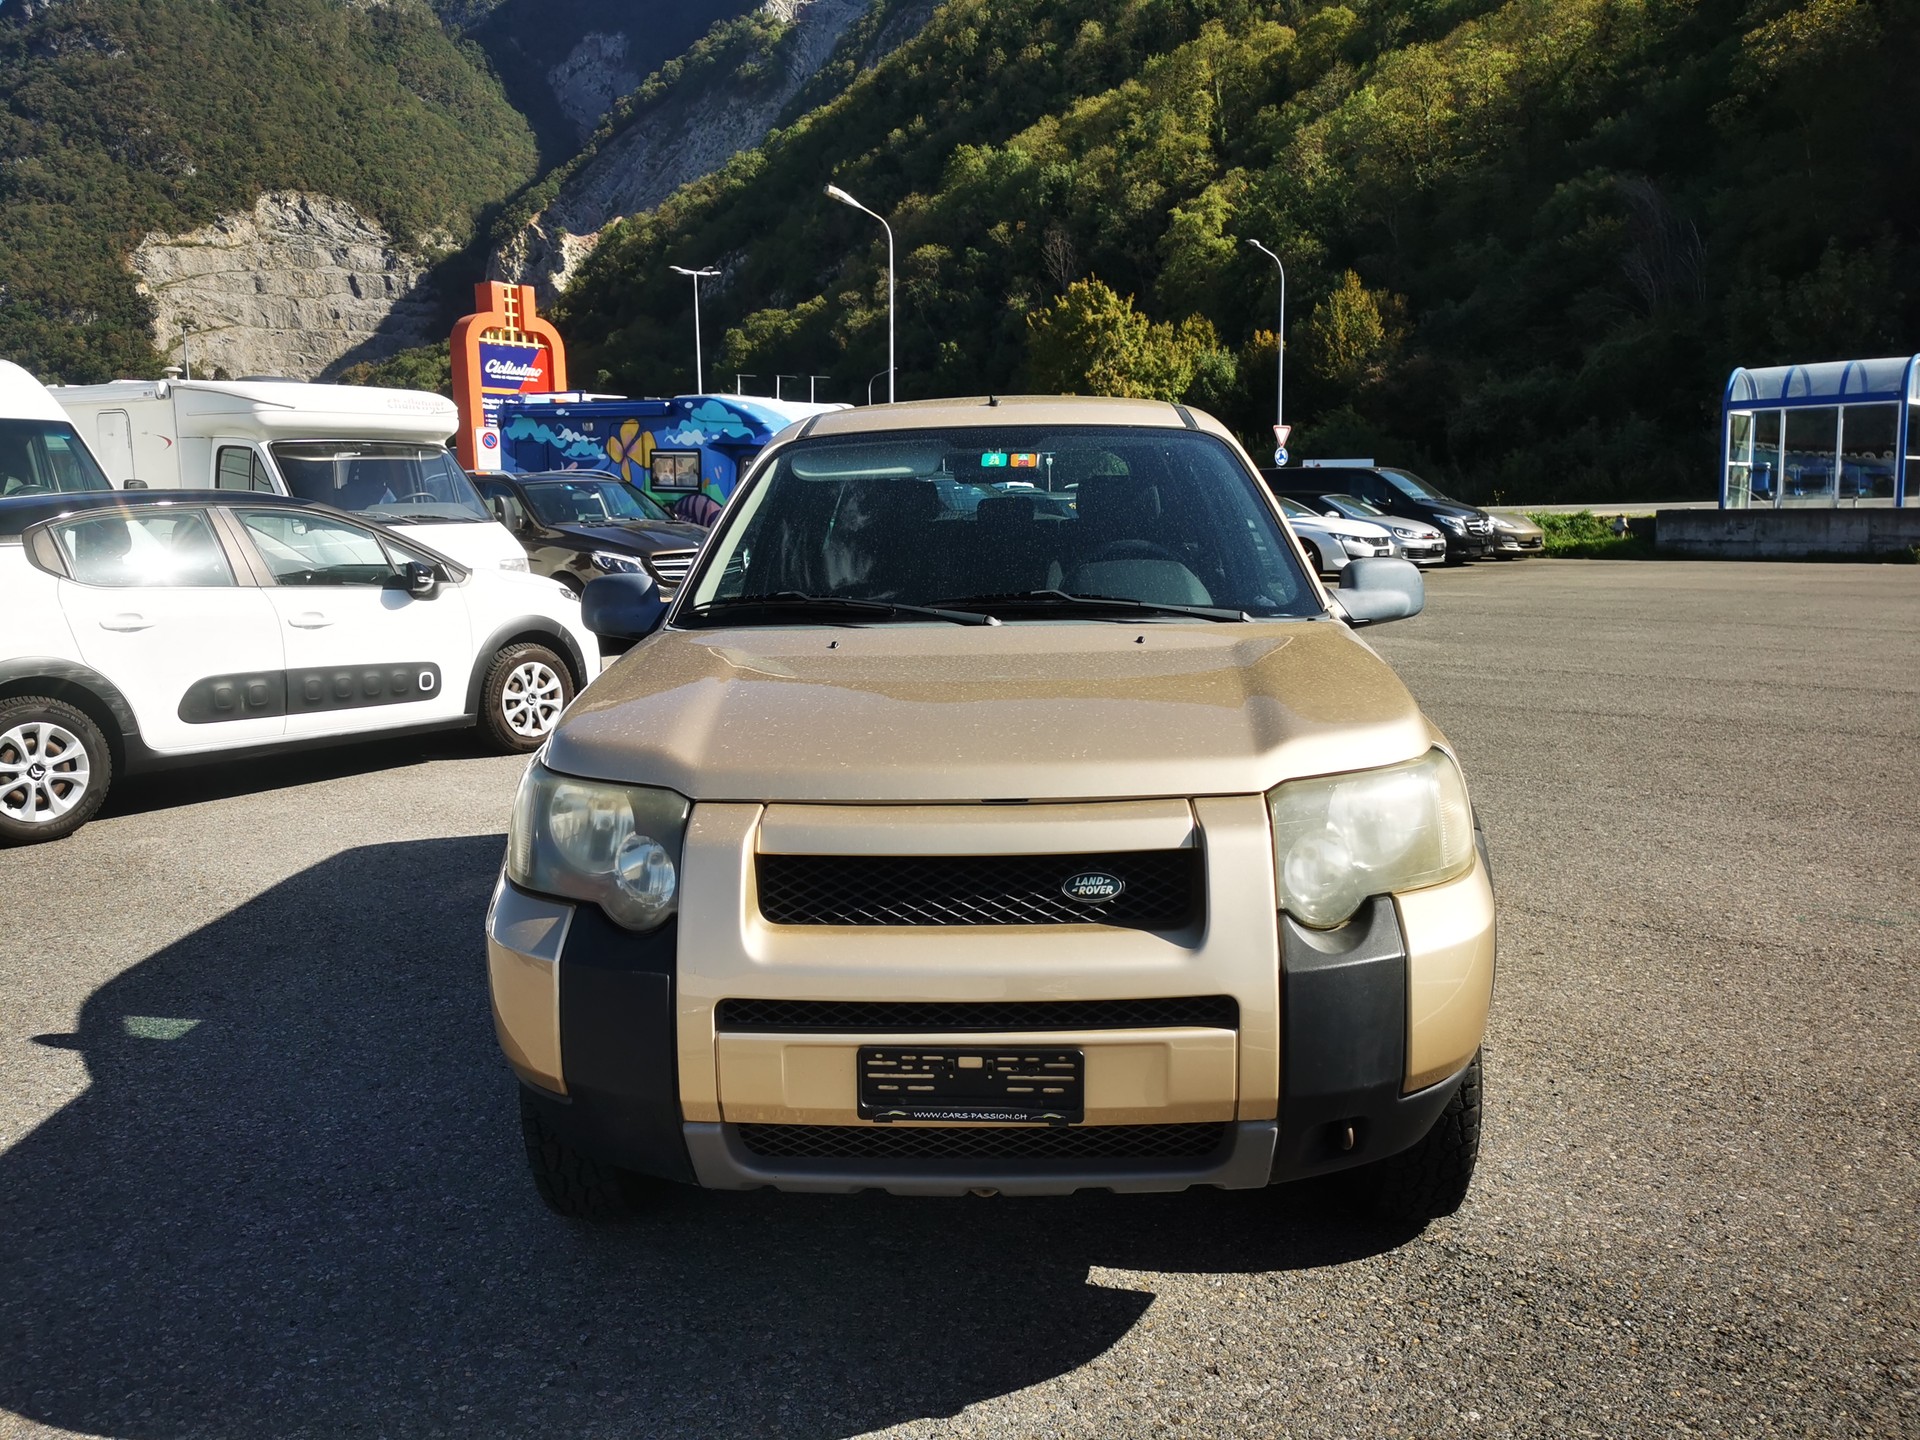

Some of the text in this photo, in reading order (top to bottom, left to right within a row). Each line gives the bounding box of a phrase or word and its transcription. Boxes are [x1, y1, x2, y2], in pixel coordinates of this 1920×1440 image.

[485, 359, 543, 377] Ciclissimo
[1075, 877, 1104, 886] LAND
[1078, 885, 1114, 895] ROVER
[913, 1111, 1027, 1121] WWW.CARS-PASSION.CH
